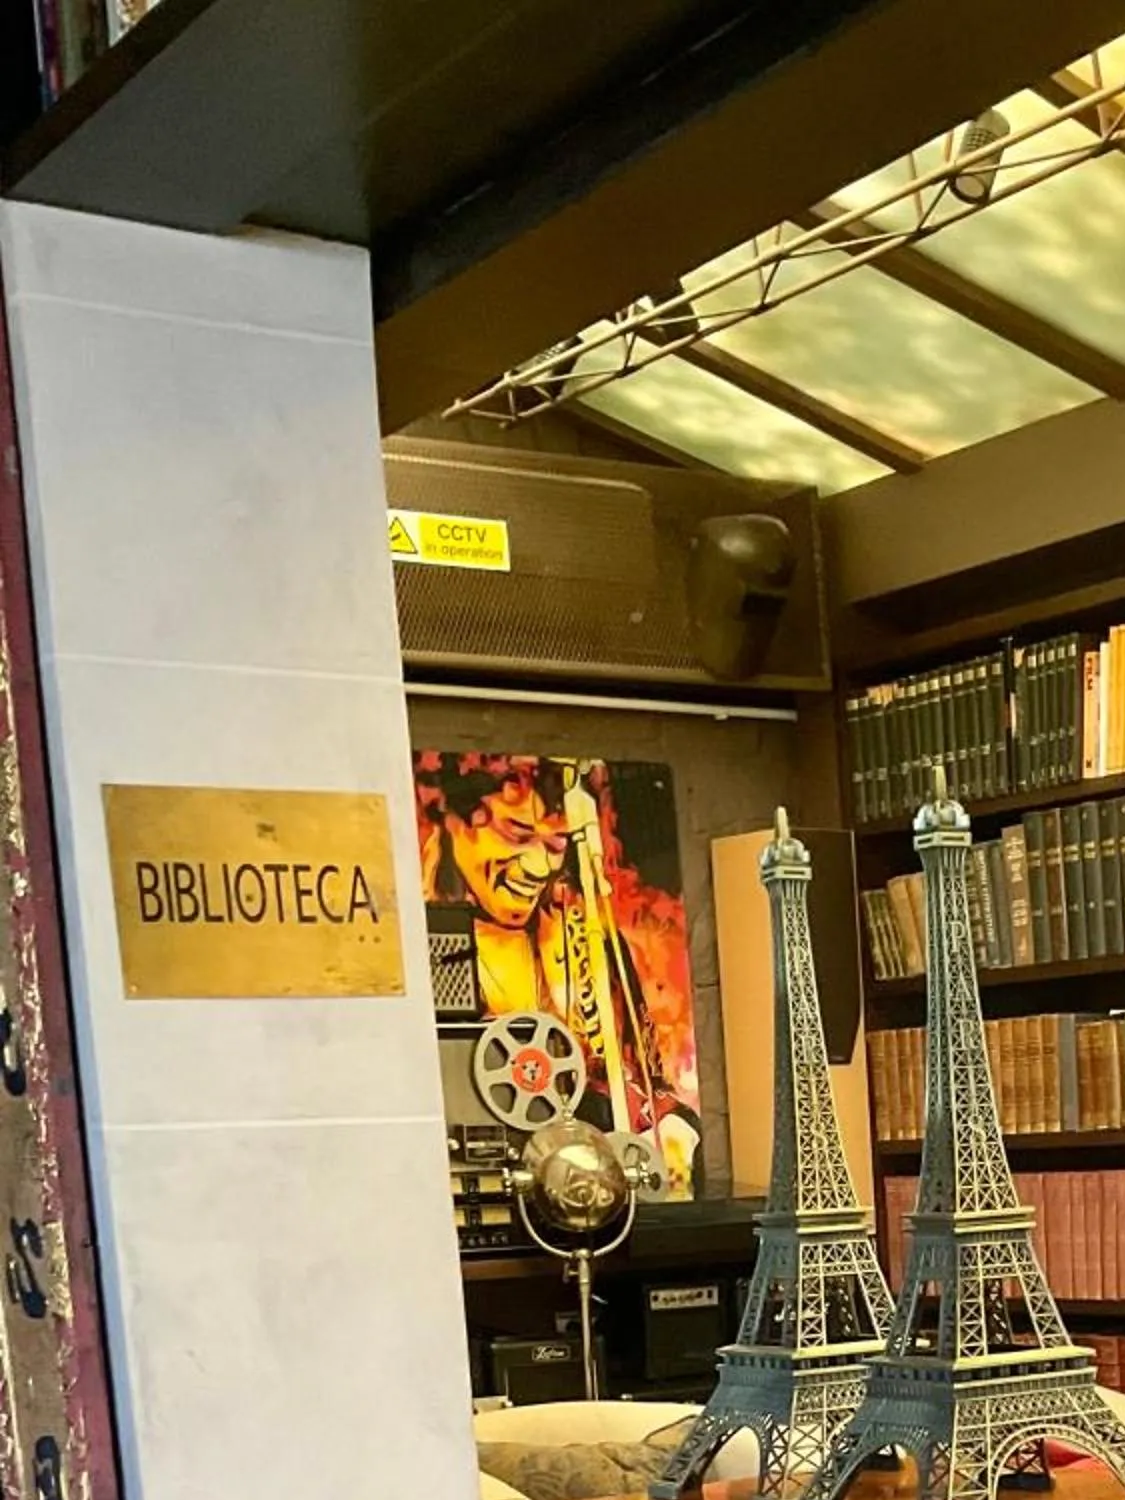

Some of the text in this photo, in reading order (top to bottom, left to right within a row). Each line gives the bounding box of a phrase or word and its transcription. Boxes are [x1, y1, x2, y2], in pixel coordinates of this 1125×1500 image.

[438, 523, 487, 543] CCTV
[441, 545, 503, 560] operation
[135, 862, 379, 924] BIBLIOTECA
